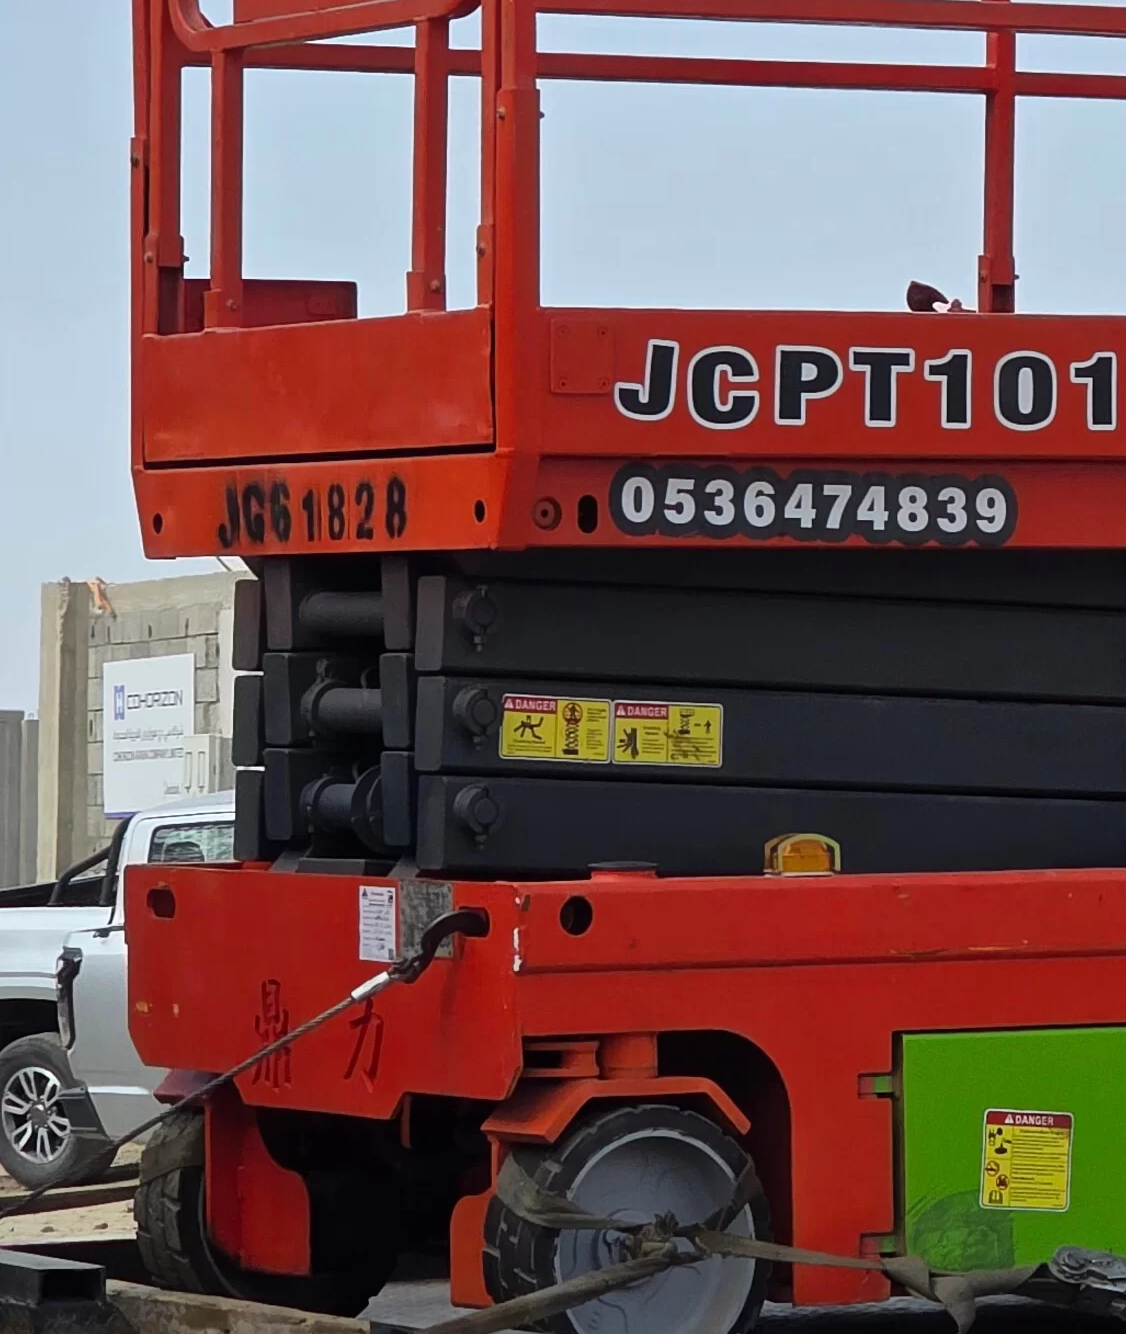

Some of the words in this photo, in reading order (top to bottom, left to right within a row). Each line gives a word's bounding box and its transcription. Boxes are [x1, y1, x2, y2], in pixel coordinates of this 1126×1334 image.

[620, 476, 1008, 534] 0536474839
[514, 698, 557, 712] DANGER
[627, 704, 668, 718] DANGER
[1014, 1114, 1055, 1126] DANGER
